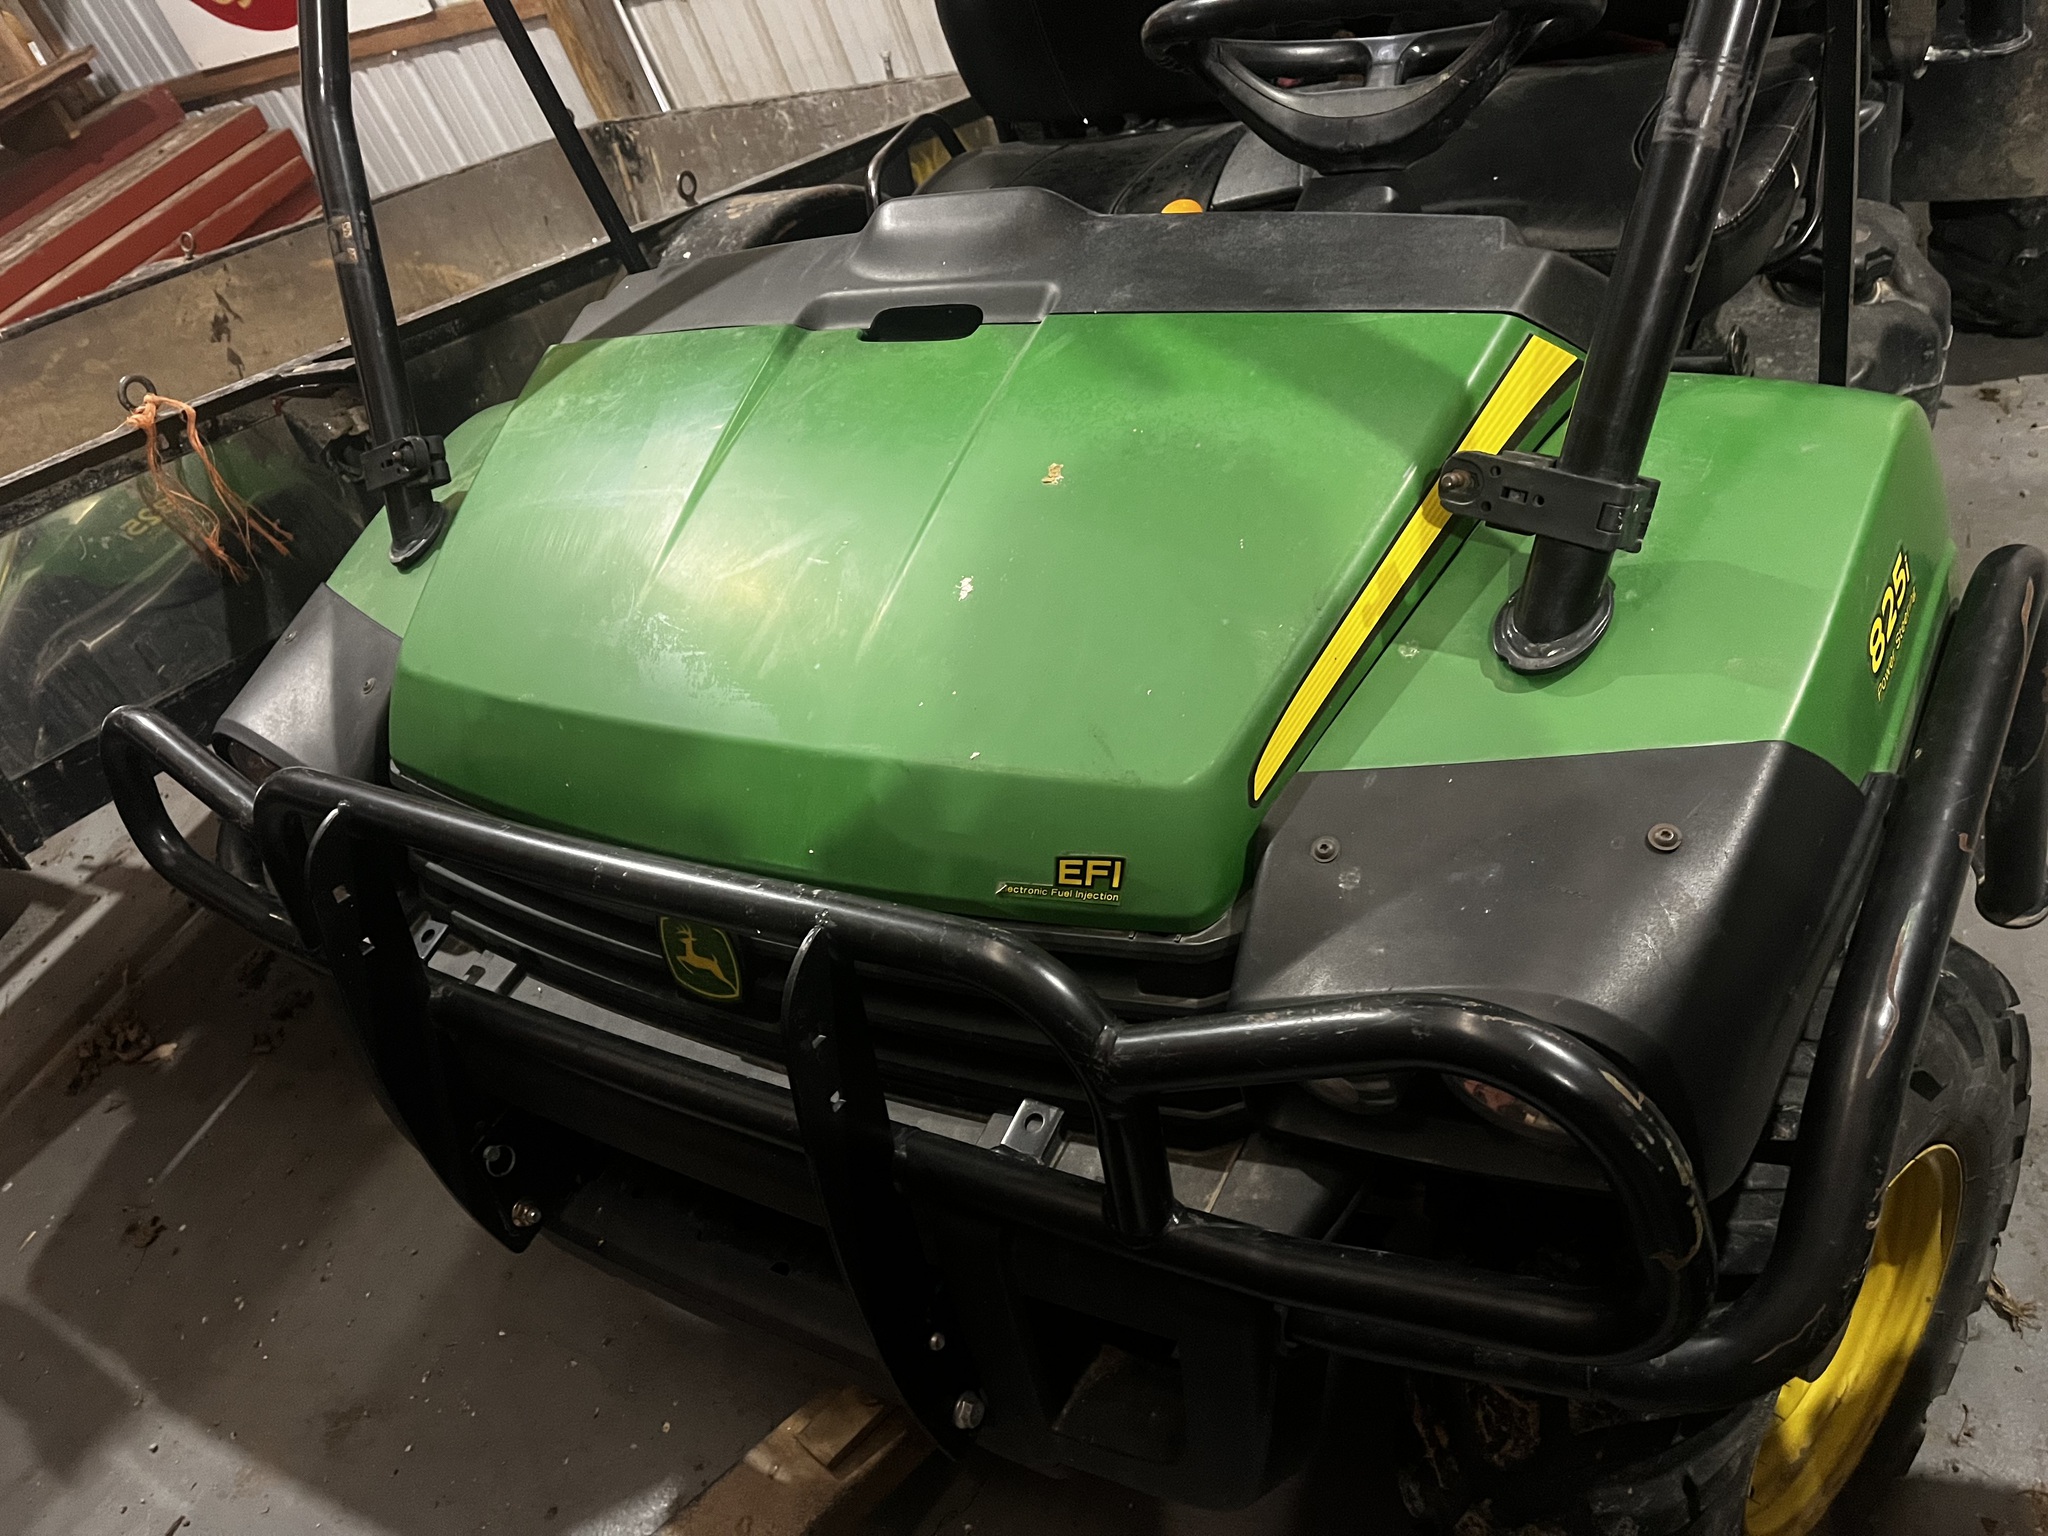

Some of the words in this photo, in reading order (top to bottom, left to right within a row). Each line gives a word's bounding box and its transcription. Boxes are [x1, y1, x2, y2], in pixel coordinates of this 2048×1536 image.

[1869, 551, 1910, 673] 825i
[1878, 649, 1897, 702] Power
[1004, 885, 1048, 896] ectronic
[1050, 888, 1073, 898] Fuel
[1075, 890, 1119, 902] Injection
[1058, 859, 1122, 888] EFI
